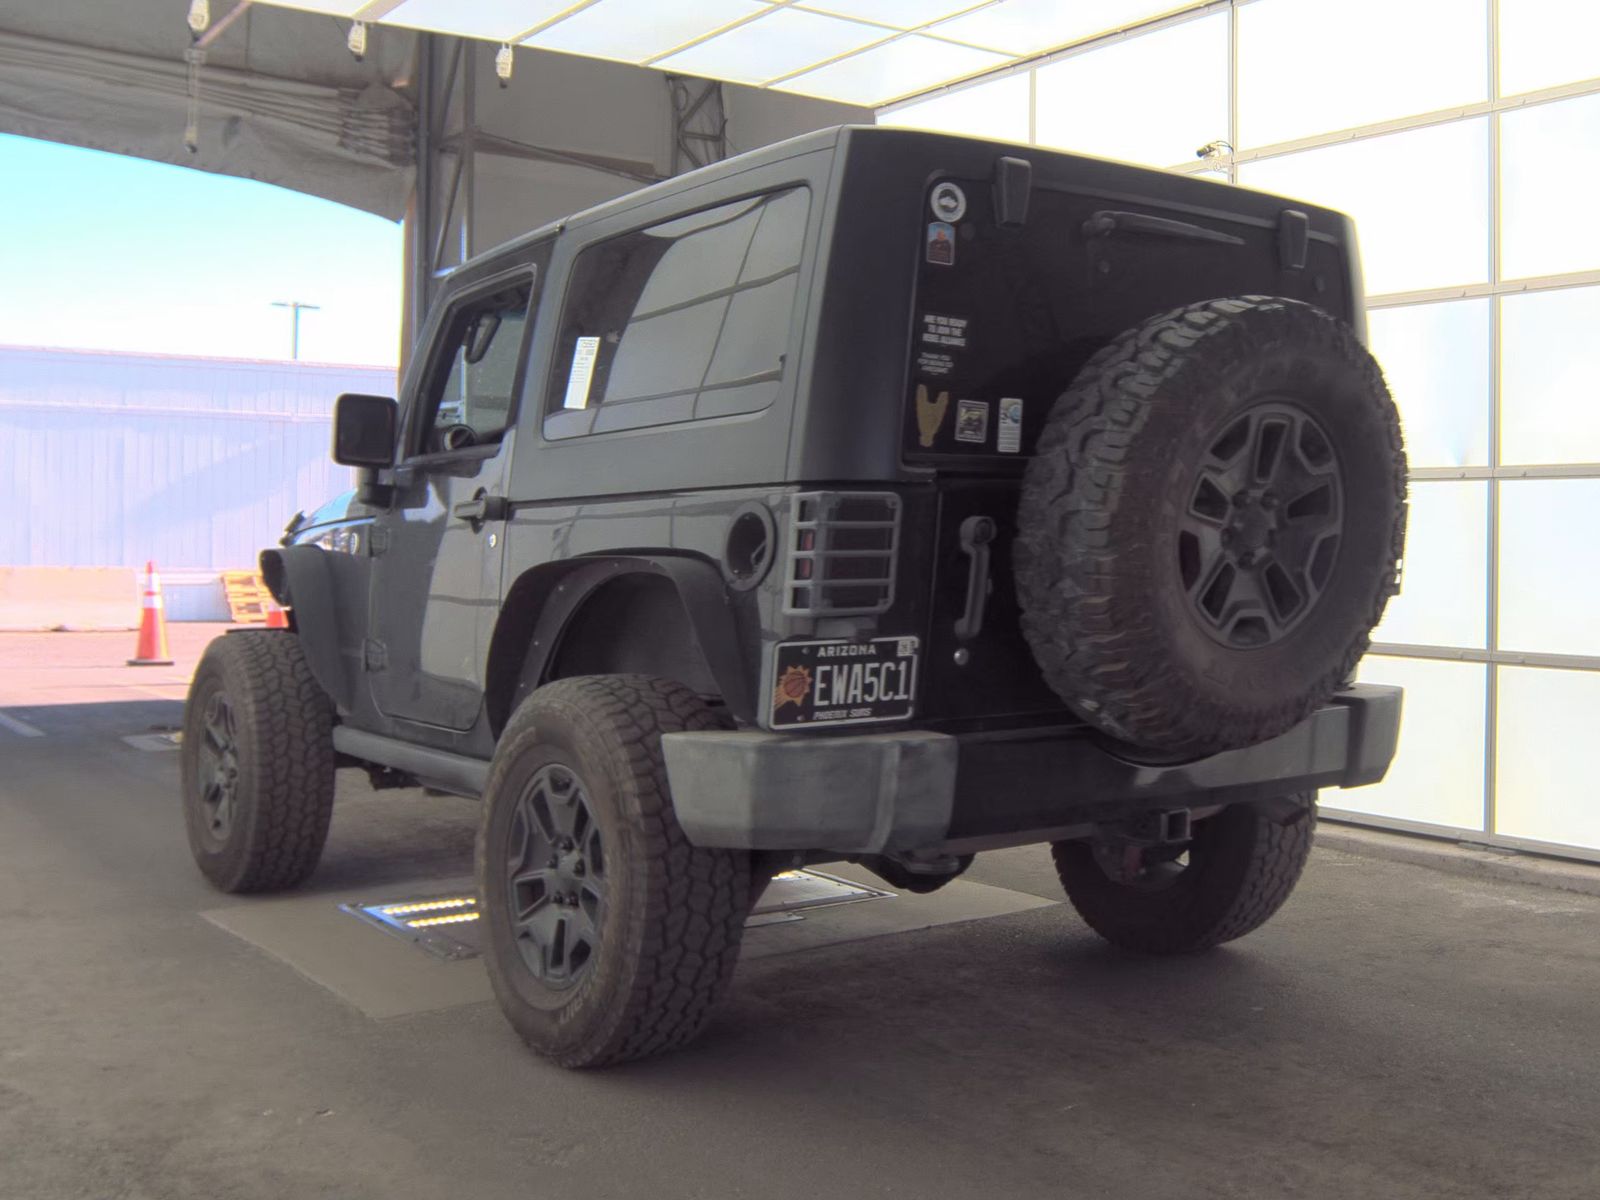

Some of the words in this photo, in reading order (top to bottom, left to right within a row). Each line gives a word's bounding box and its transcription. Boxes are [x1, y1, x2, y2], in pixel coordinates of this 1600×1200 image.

[817, 644, 877, 657] ARIZONA
[813, 660, 909, 706] EWA5C1
[813, 709, 848, 720] PHOENIX
[849, 708, 873, 718] SUNS
